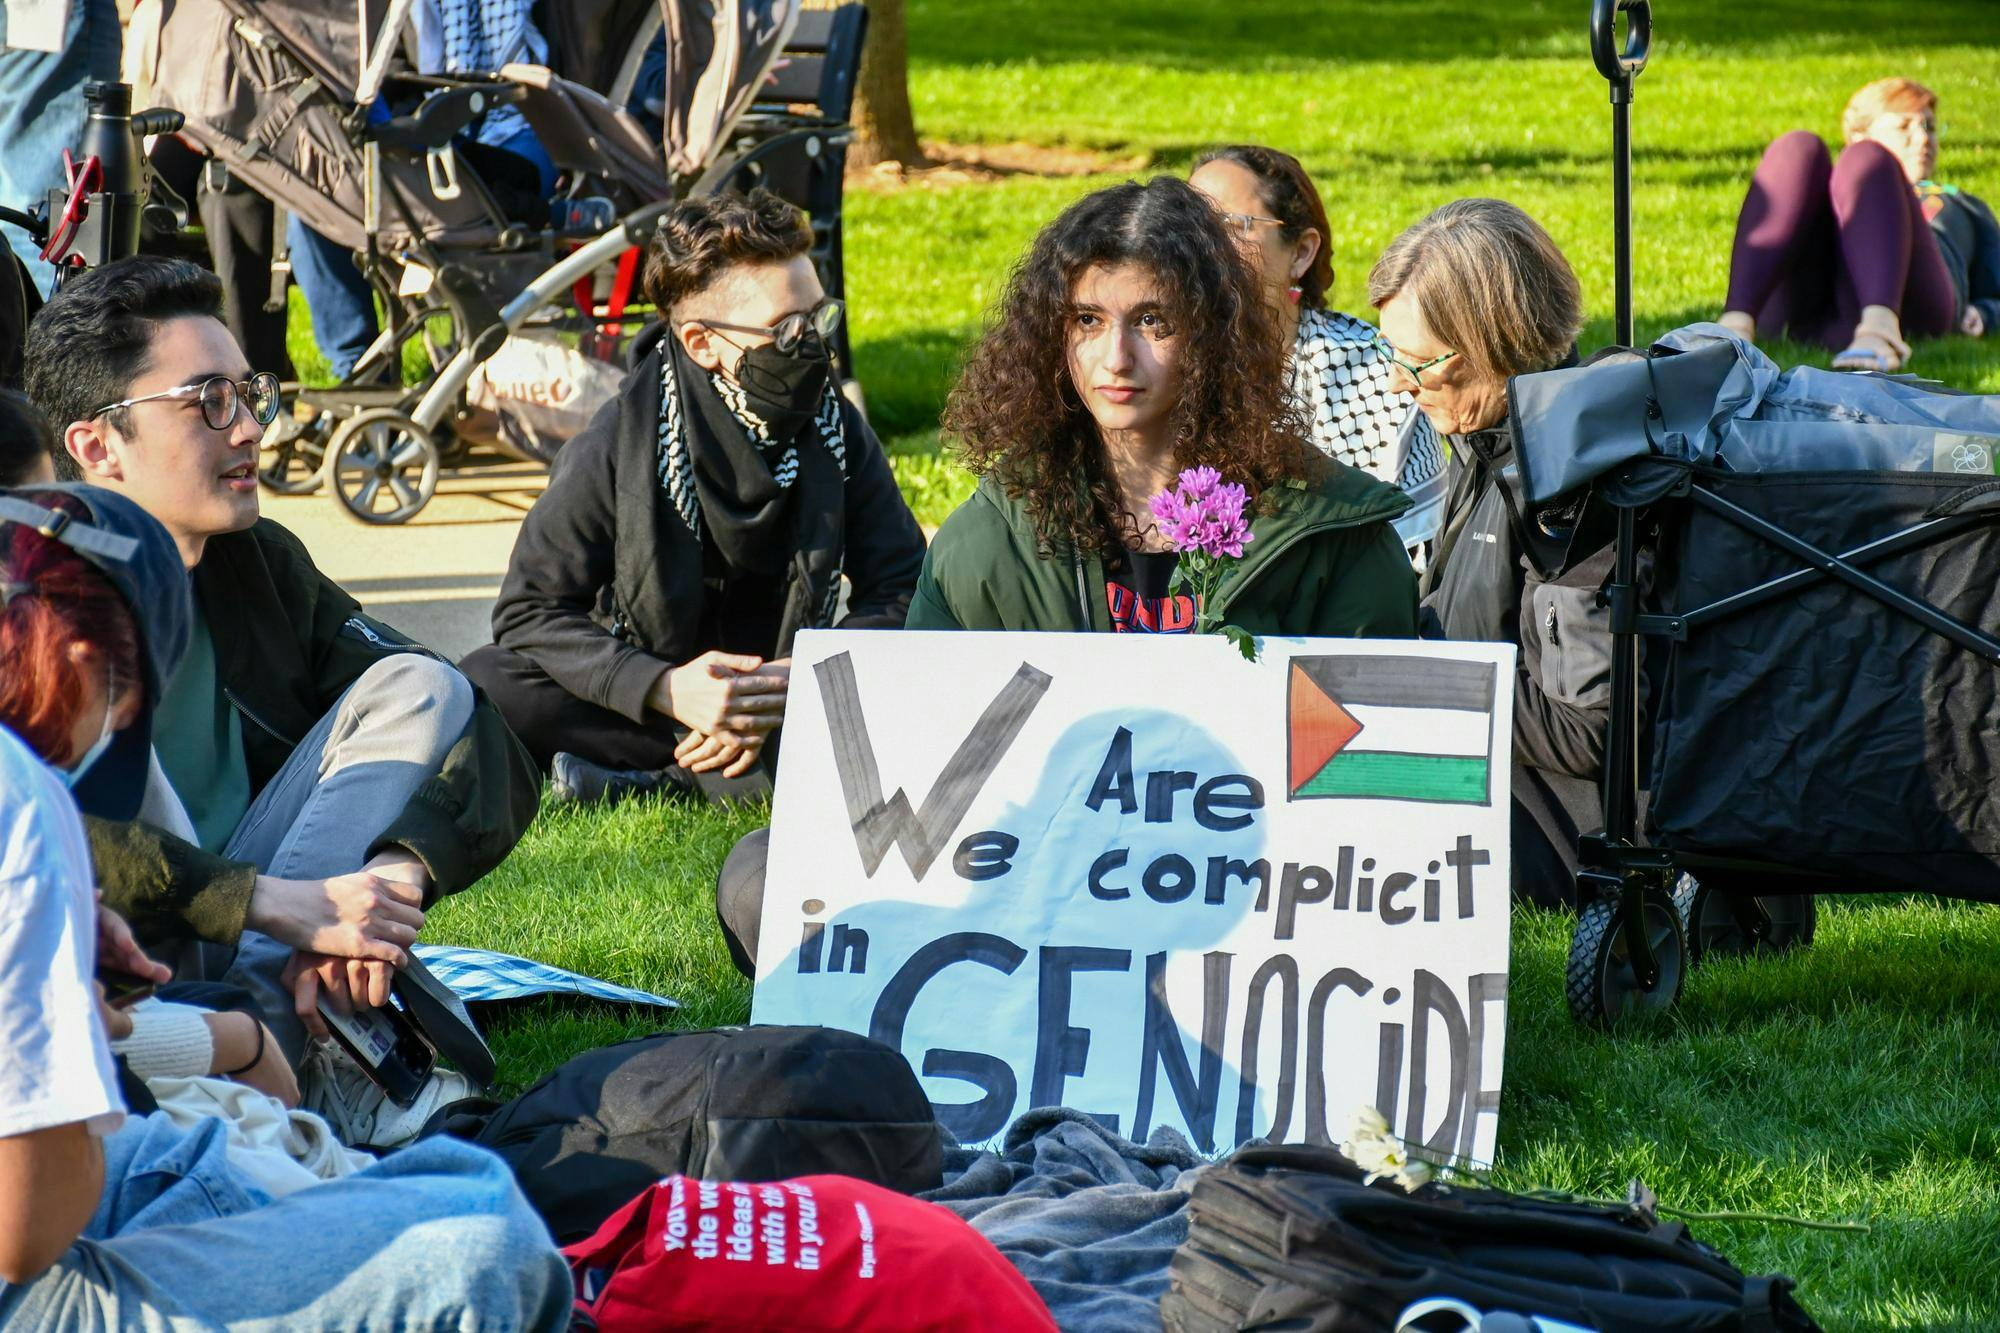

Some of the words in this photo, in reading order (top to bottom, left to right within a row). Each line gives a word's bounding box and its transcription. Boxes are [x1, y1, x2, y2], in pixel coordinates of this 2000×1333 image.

[813, 650, 1053, 882] We
[1085, 726, 1264, 831] Are
[1087, 835, 1489, 940] complicit
[798, 899, 869, 974] in
[691, 1214, 719, 1259] the
[726, 1196, 753, 1261] ideas
[759, 1212, 786, 1265] with
[797, 1197, 825, 1246] your
[793, 1247, 820, 1270] in
